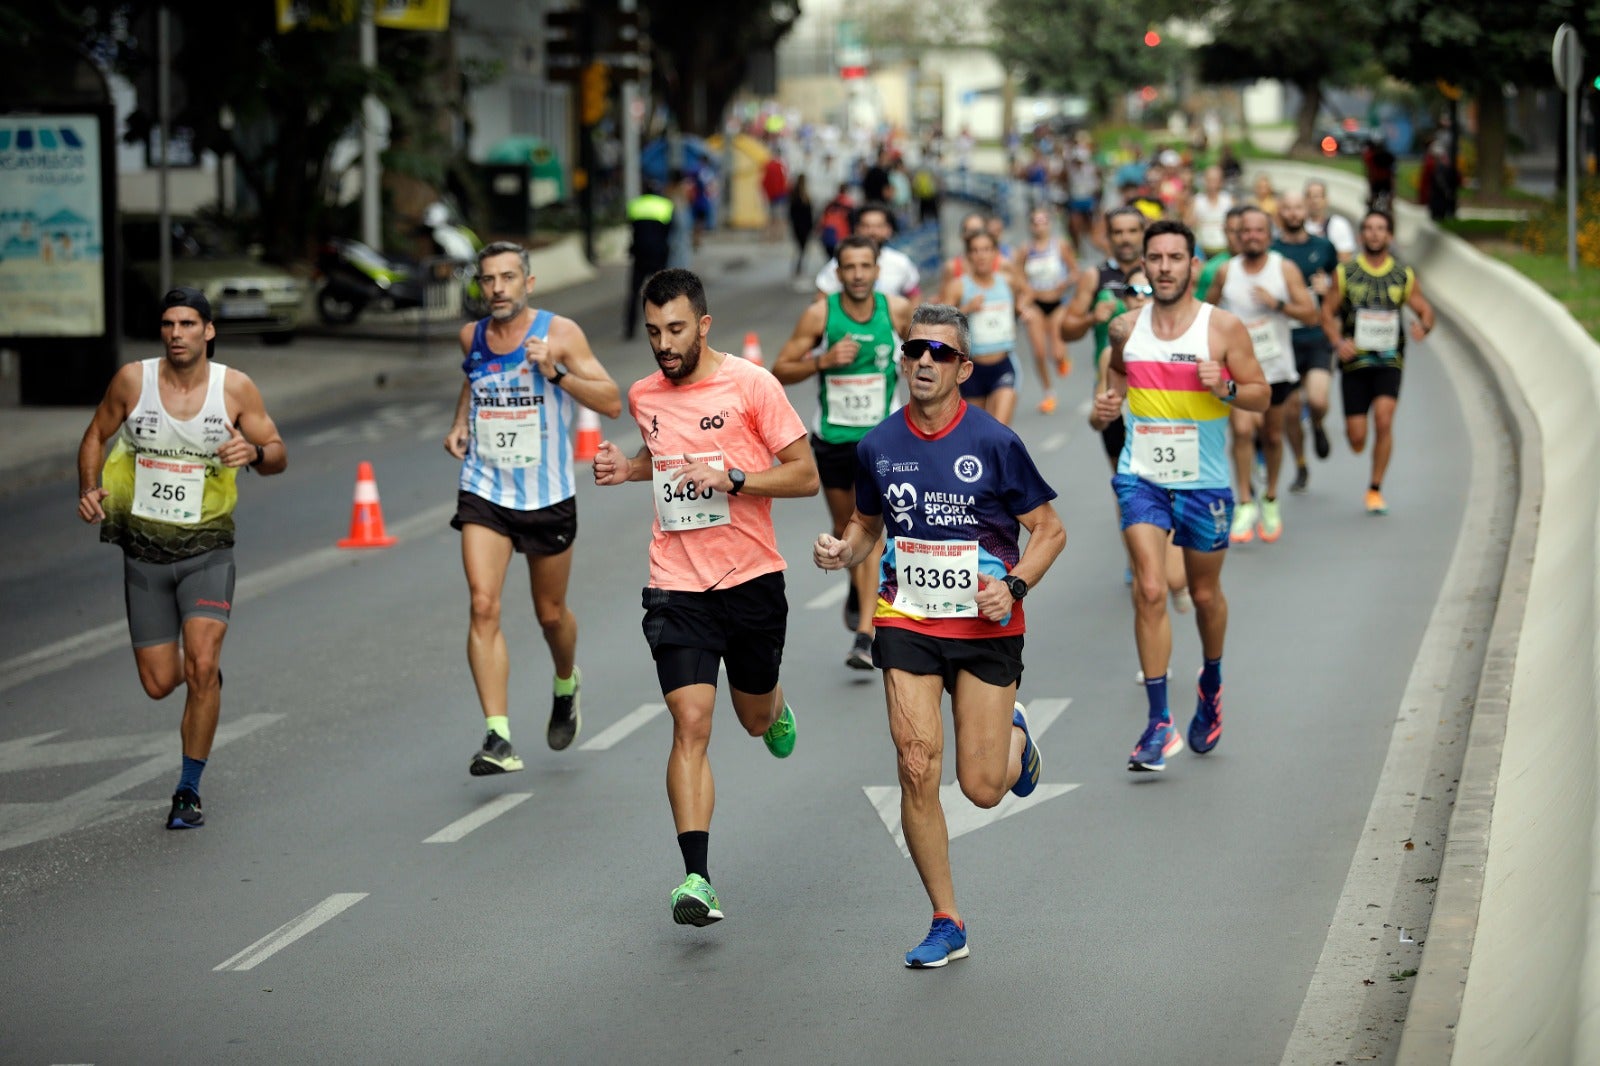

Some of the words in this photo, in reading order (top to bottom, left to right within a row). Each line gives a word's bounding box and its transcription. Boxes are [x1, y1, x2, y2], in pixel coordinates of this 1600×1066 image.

[844, 395, 871, 408] 133
[699, 415, 724, 430] GO
[496, 432, 517, 448] 37
[1153, 447, 1175, 463] 33
[654, 460, 667, 472] 42
[892, 464, 919, 473] MELILLA
[151, 482, 185, 501] 256
[924, 491, 976, 506] MELILLA
[924, 503, 967, 515] SPORT
[925, 513, 979, 526] CAPITAL
[896, 540, 915, 554] 42
[903, 565, 972, 589] 13363
